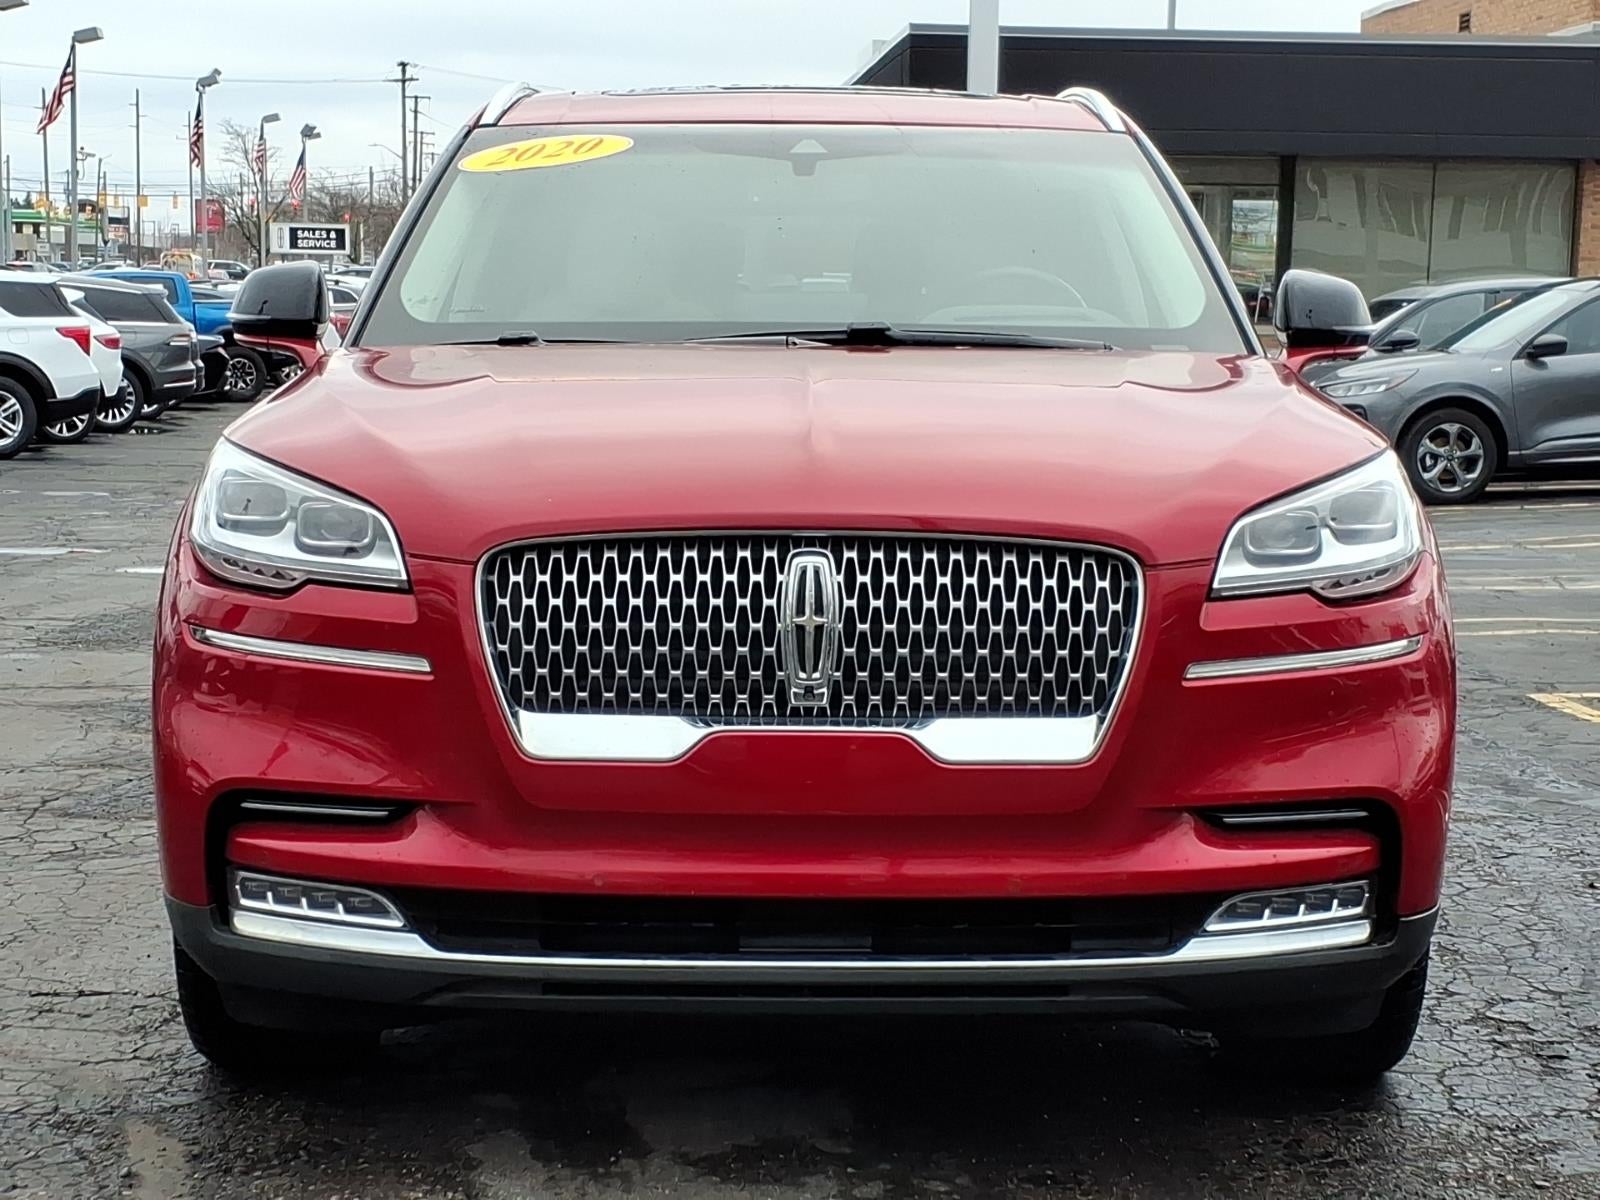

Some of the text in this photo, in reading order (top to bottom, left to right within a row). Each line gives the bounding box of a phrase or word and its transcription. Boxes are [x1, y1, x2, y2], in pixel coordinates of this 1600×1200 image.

[484, 136, 604, 167] 2020
[297, 230, 337, 239] SALES &
[297, 239, 337, 248] SERVICE
